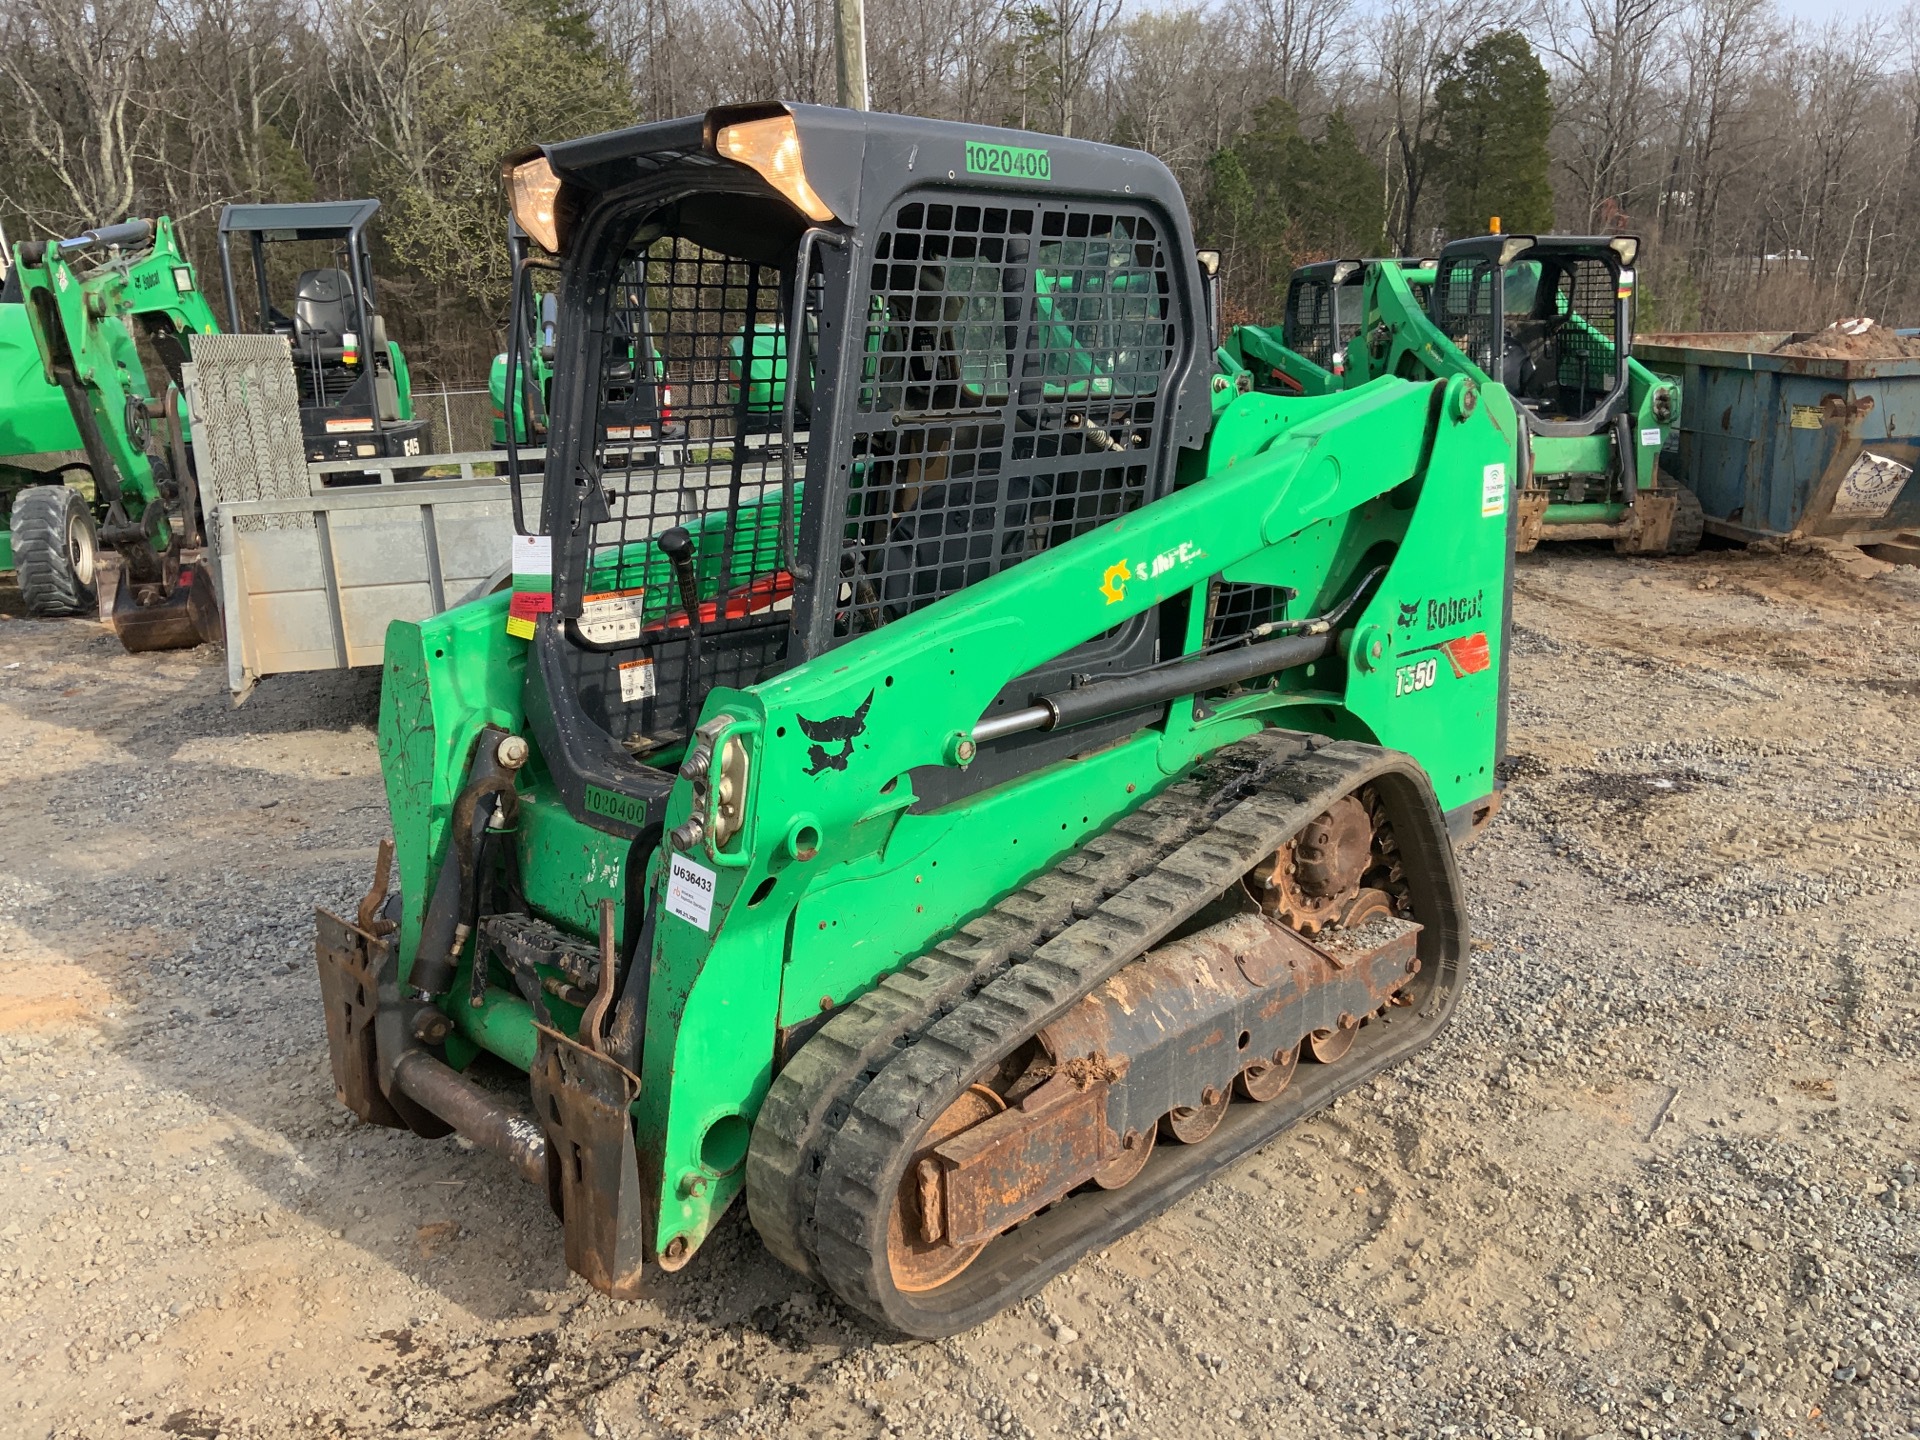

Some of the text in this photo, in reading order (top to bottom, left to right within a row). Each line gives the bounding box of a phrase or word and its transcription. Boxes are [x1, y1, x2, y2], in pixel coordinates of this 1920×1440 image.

[967, 146, 1049, 177] 1020400
[404, 438, 420, 457] E45
[1427, 589, 1483, 631] Bobcat
[587, 790, 645, 823] 1020400
[673, 864, 713, 893] U636433
